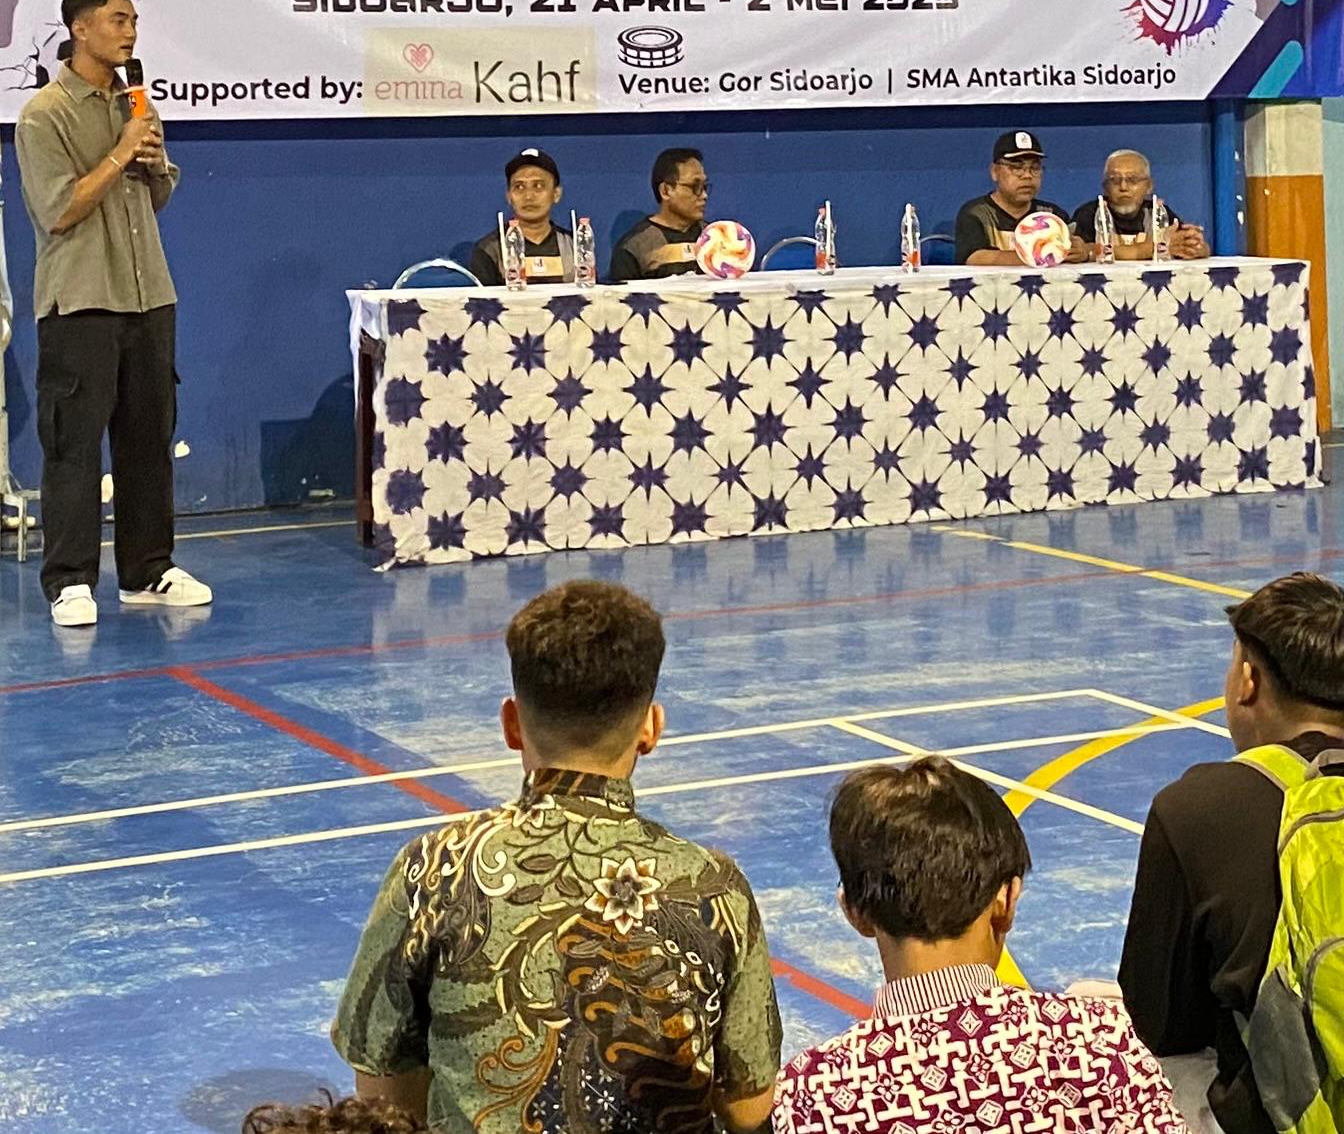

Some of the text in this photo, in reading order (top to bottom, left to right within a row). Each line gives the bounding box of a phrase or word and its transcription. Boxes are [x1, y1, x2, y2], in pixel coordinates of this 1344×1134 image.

[150, 59, 581, 106] Supported by: emina Kahf
[618, 73, 709, 95] Venue:
[719, 71, 762, 93] Gor
[770, 67, 873, 96] Sidoarjo
[906, 68, 960, 88] SMA
[967, 64, 1076, 88] Antartika
[1083, 62, 1176, 89] Sidoarjo
